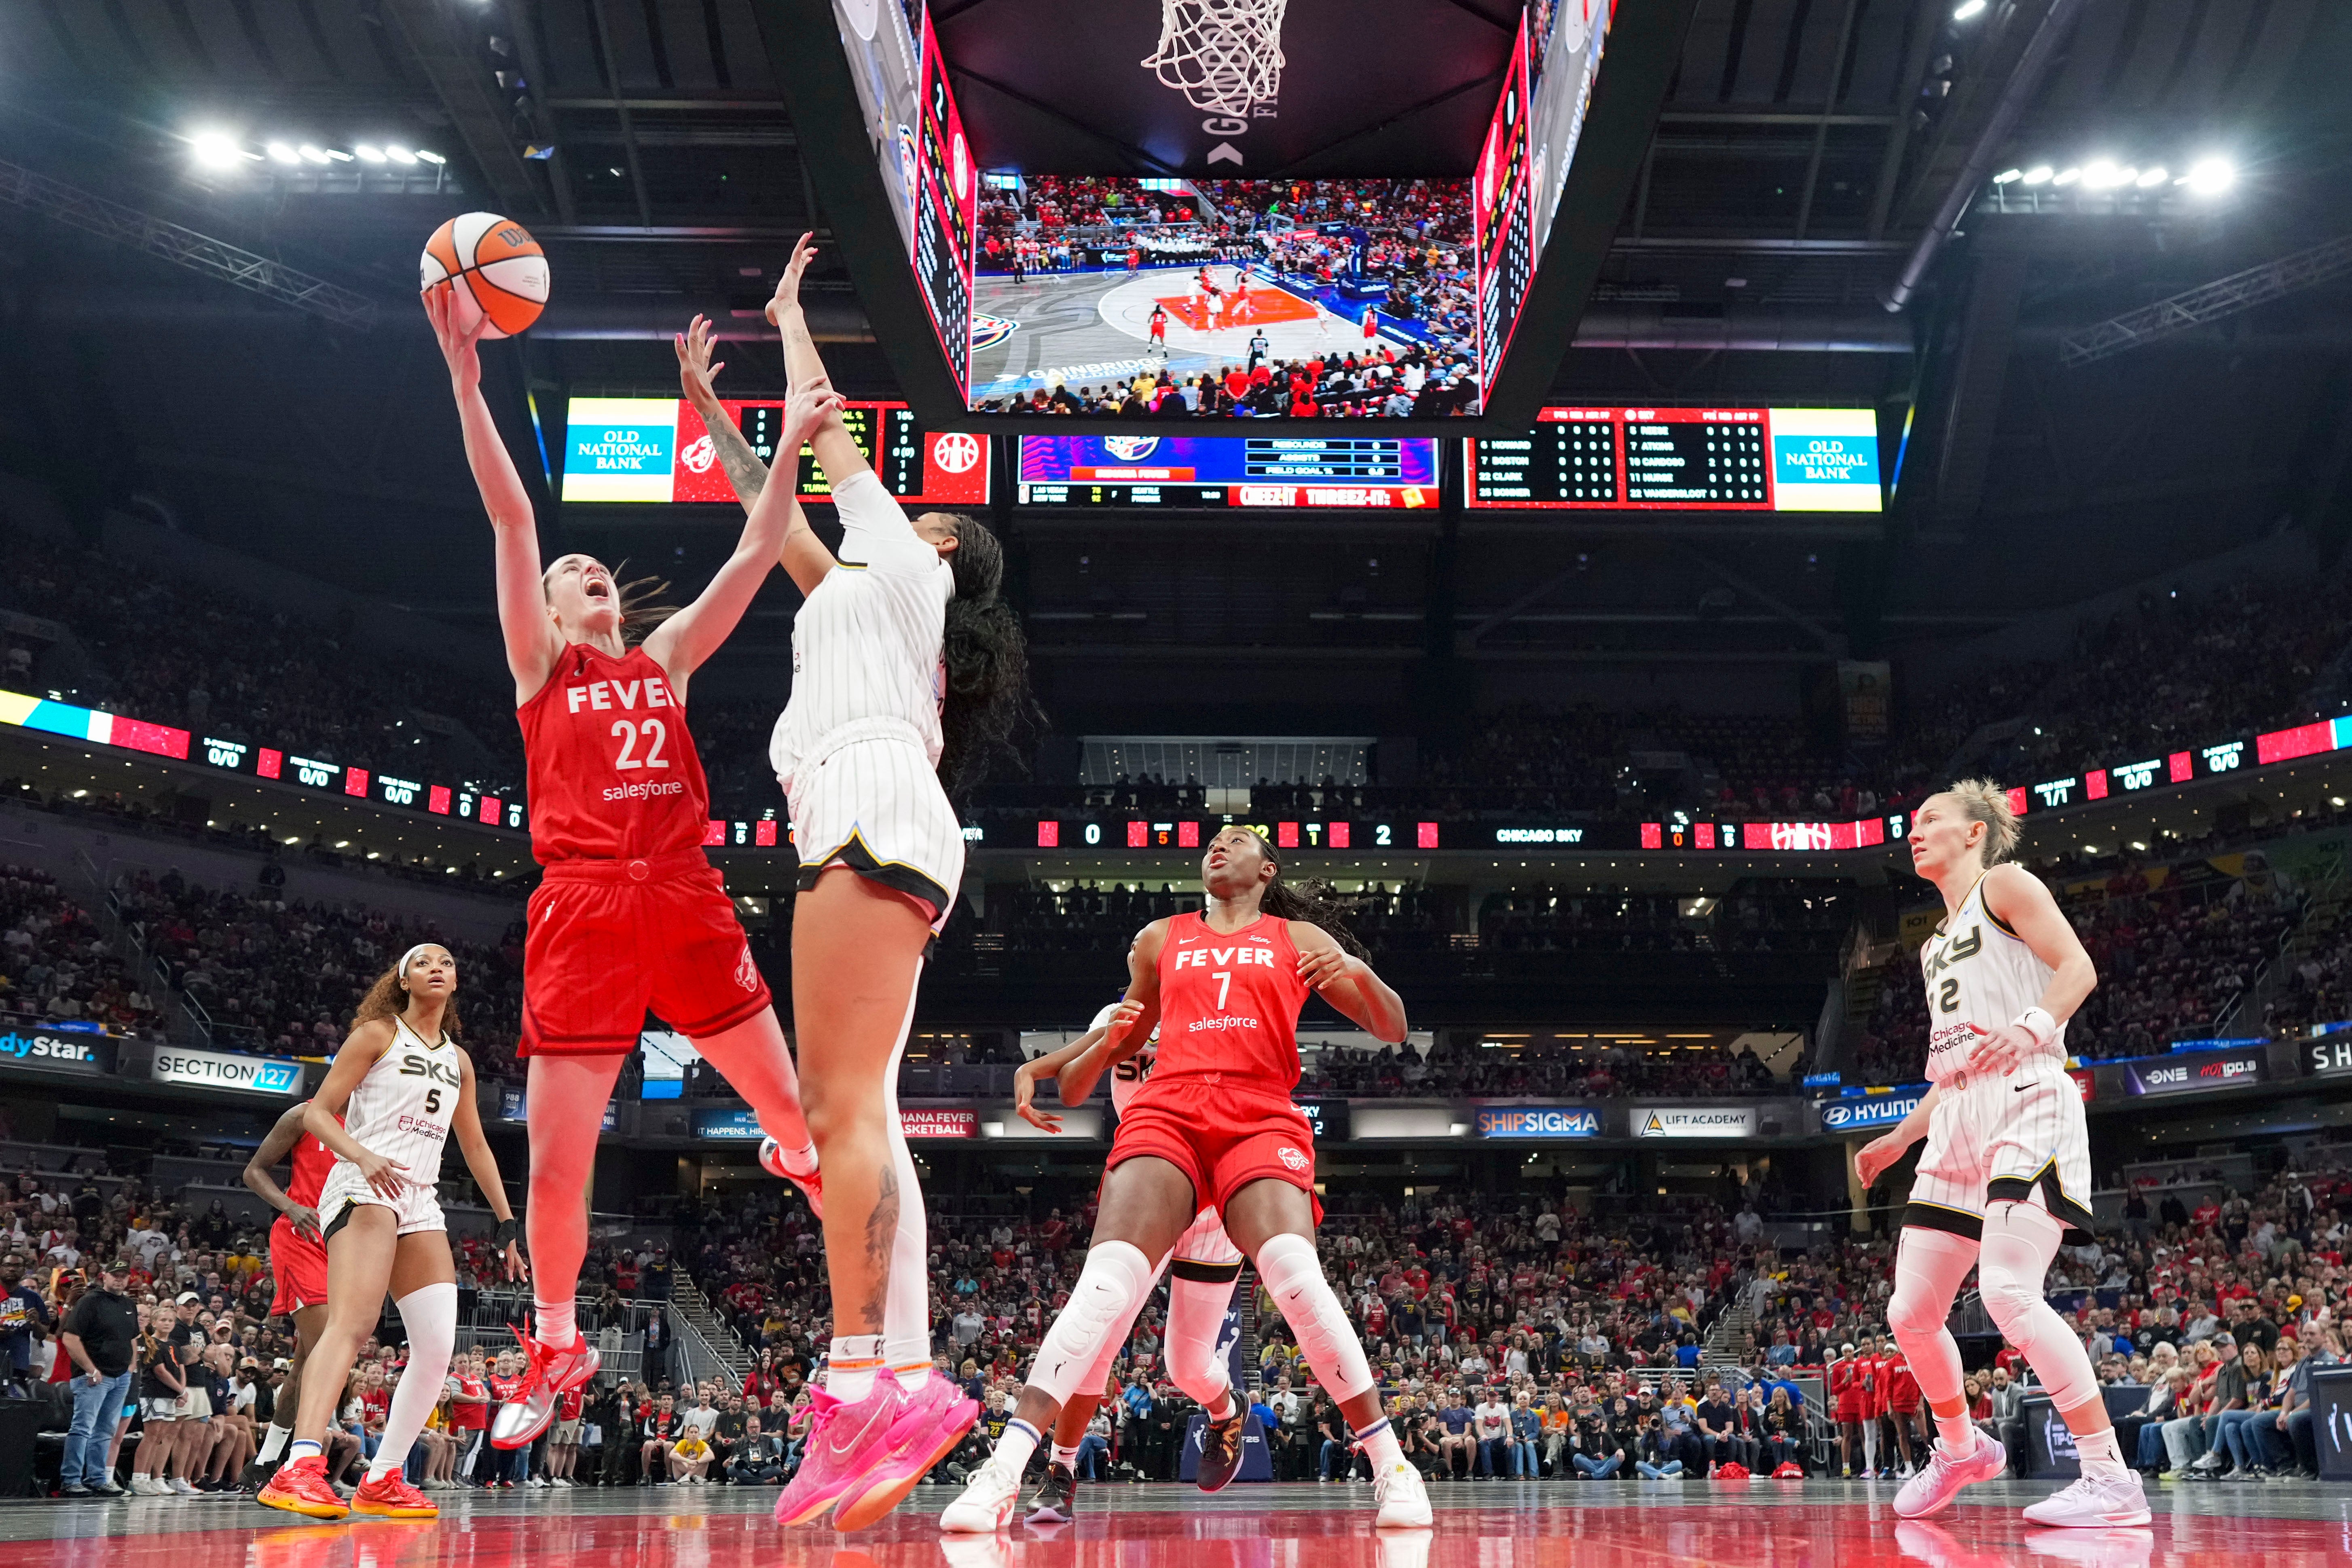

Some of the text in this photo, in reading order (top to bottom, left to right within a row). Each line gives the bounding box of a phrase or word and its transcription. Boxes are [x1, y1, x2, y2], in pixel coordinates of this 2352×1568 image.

[855, 411, 864, 420] %
[858, 423, 866, 432] %
[901, 423, 909, 432] 0
[604, 430, 639, 443] OLD
[854, 436, 862, 444] %
[900, 436, 908, 444] 0
[577, 443, 662, 456] NATIONAL
[1272, 441, 1326, 449] REBOUNDS
[1491, 441, 1531, 450] HOWARD
[1808, 440, 1843, 453] OLD
[596, 457, 642, 469] BANK
[1492, 456, 1529, 466] BOSTON
[1786, 453, 1868, 466] NATIONAL
[1324, 467, 1334, 475] %
[1492, 472, 1523, 481] CLARK
[1805, 466, 1851, 479] BANK
[1306, 488, 1391, 505] THREEZ-IT:
[567, 678, 675, 713] FEVE
[611, 719, 669, 770] 22
[208, 748, 239, 767] 0/0
[2209, 751, 2239, 772] 0/0
[299, 767, 329, 786] 0/0
[2124, 770, 2152, 789] 0/0
[385, 785, 412, 804] 0/0
[2043, 787, 2067, 806] 1/1
[460, 802, 470, 817] 0
[510, 813, 520, 827] 0
[736, 829, 746, 844] 5
[1086, 824, 1100, 844] 0
[1158, 831, 1168, 844] 5
[1376, 825, 1391, 844] 2
[1497, 829, 1582, 842] CHICAGO SKY
[1892, 823, 1902, 838] 0
[1309, 832, 1317, 845] 1
[1673, 833, 1683, 846] 0
[1724, 833, 1734, 847] 5
[1175, 947, 1274, 970] FEVER
[1212, 971, 1231, 1011] 7
[1189, 1015, 1257, 1032] salesforce
[1929, 1031, 1975, 1058] Medicine
[157, 1056, 291, 1086] SECTION 127
[398, 1054, 461, 1090] SKY
[2200, 1061, 2226, 1077] HOT
[425, 1088, 442, 1115] 5
[505, 1093, 519, 1102] 988
[1855, 1098, 1922, 1121] HYUND
[937, 1113, 974, 1123] FEVER
[1478, 1113, 1599, 1132] SHIPSIGMA
[1666, 1115, 1746, 1124] LIFT ACADEMY
[416, 1119, 446, 1134] UChicago
[706, 1127, 748, 1135] HAPPENS.
[902, 1124, 967, 1134] SKETBALL
[1314, 1121, 1323, 1135] 2
[410, 1127, 444, 1143] Medicine
[501, 1390, 514, 1399] 22
[990, 1426, 1000, 1435] 22
